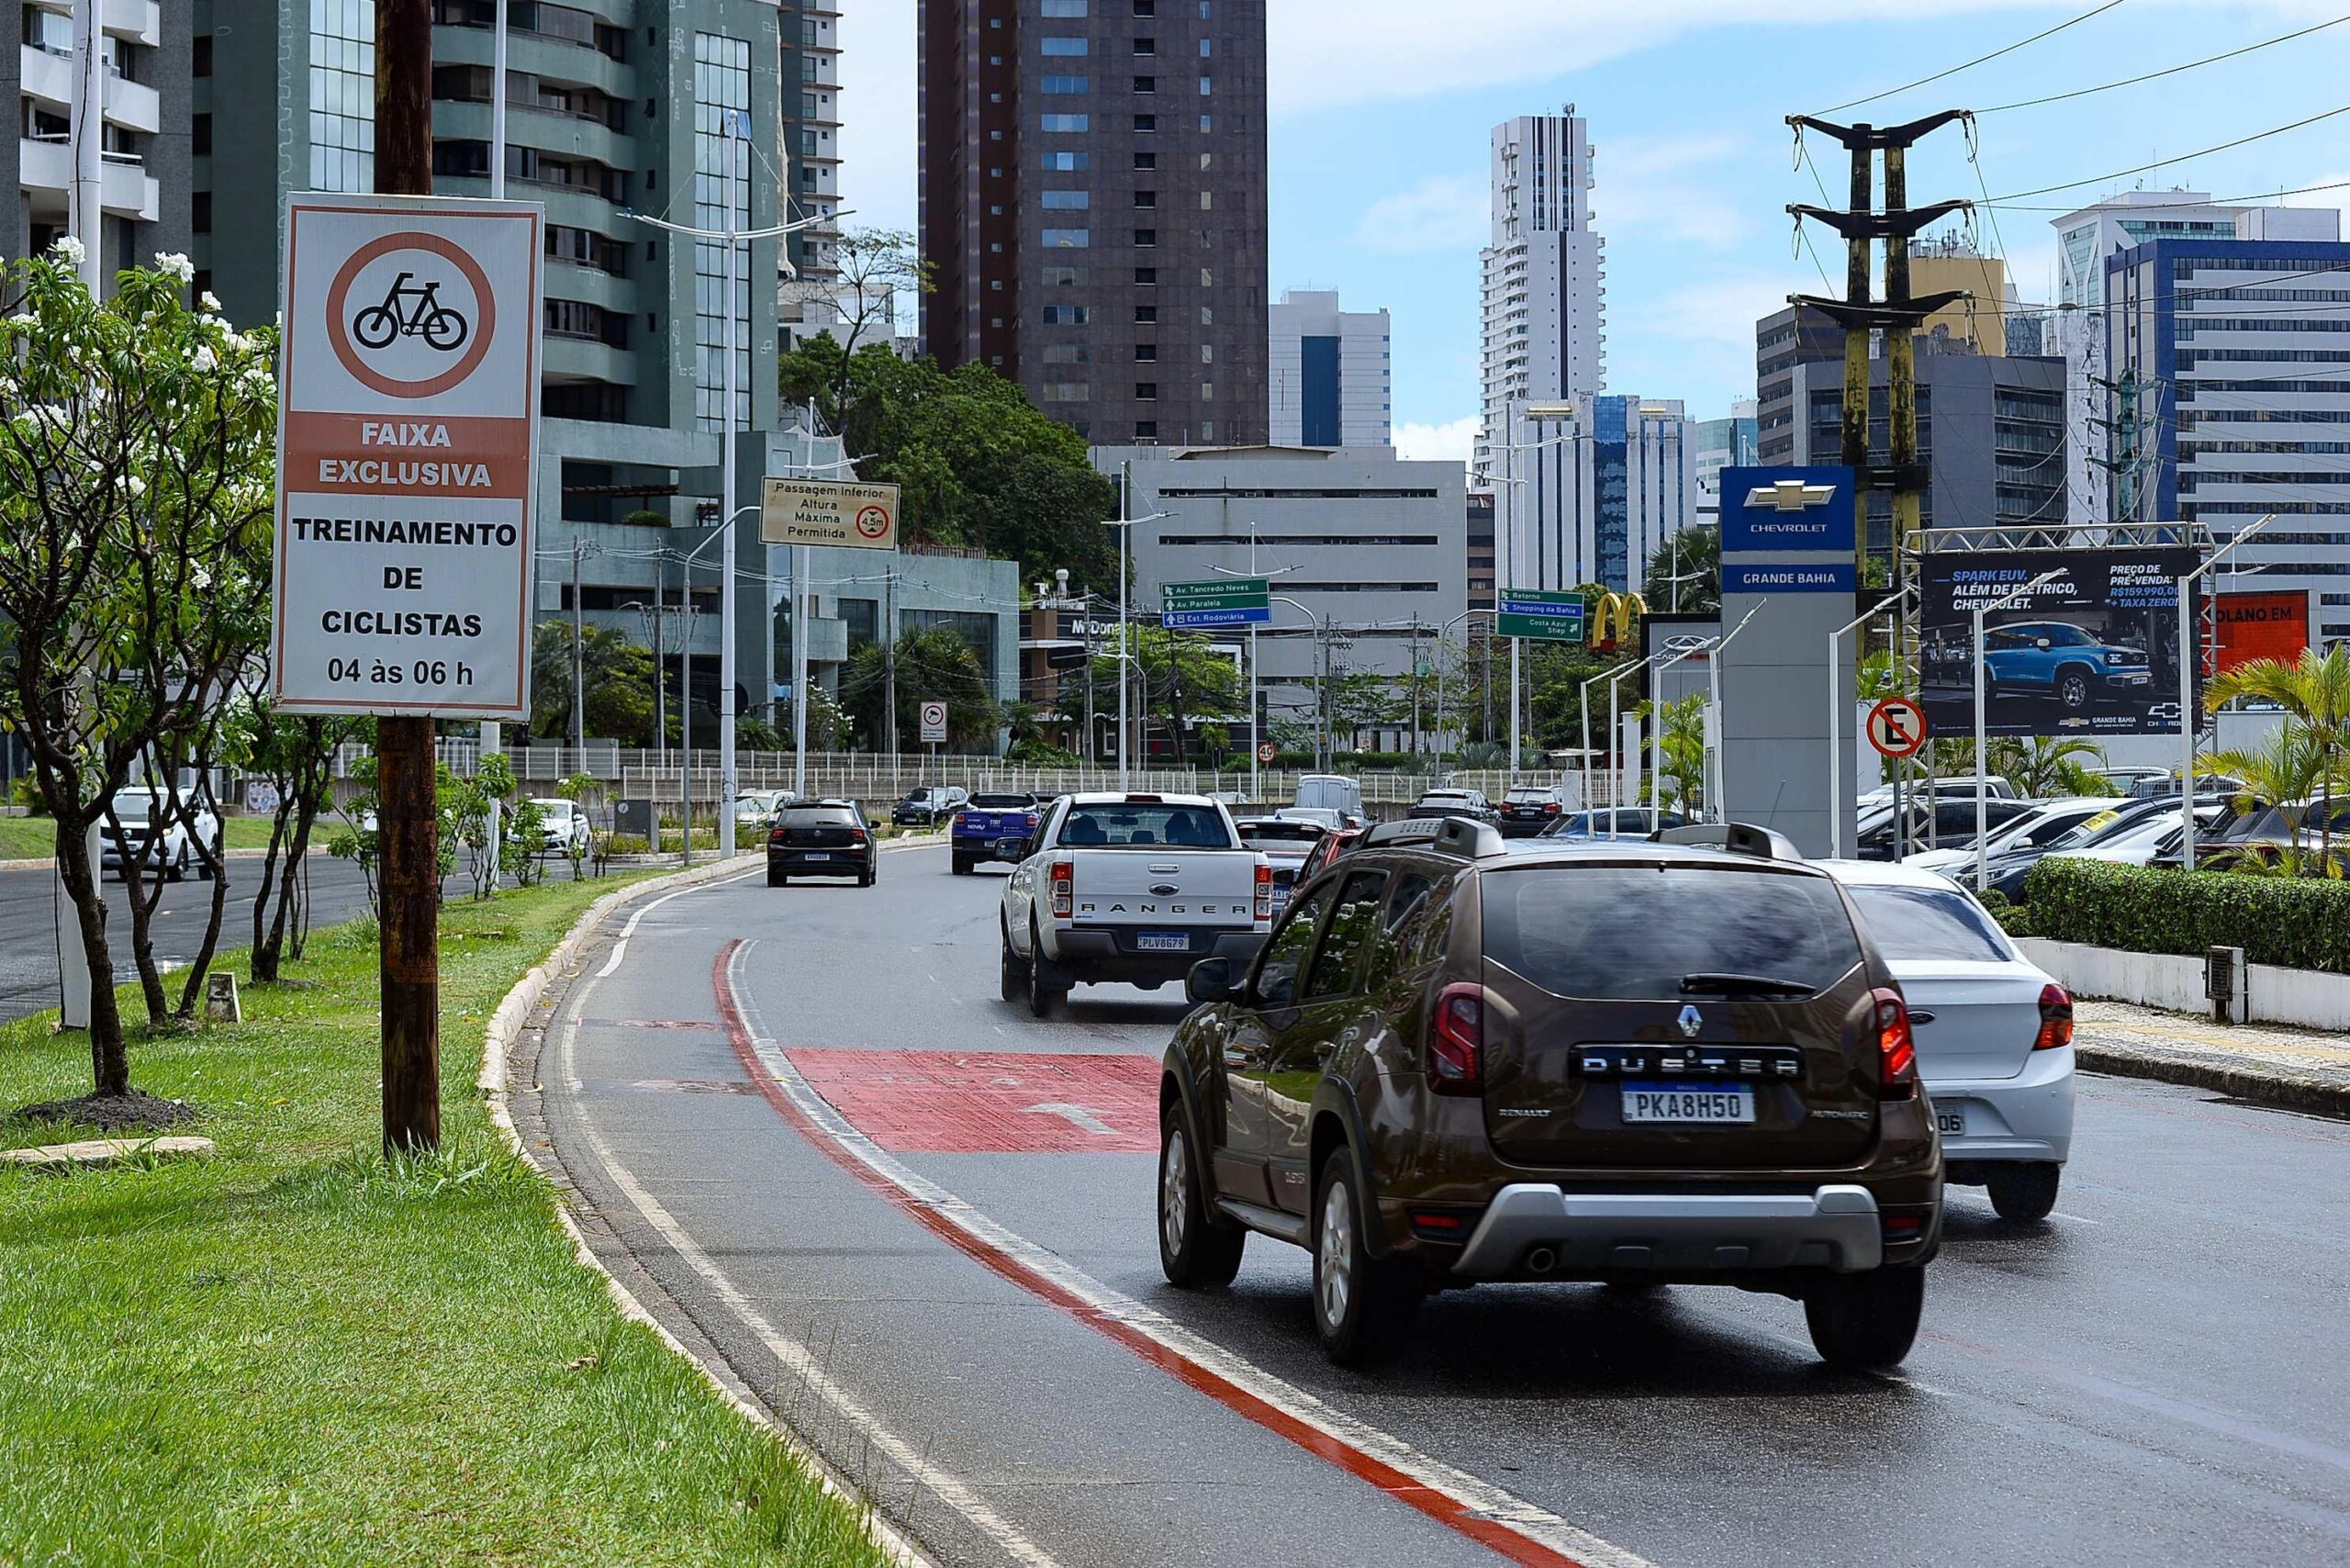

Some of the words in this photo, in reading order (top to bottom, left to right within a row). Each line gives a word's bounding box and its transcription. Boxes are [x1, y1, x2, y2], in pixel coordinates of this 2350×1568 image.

[362, 422, 452, 447] FAIXA
[319, 459, 492, 487] EXCLUSIVA
[776, 482, 837, 497] Passagem
[841, 486, 884, 498] Inferior
[800, 498, 838, 510] Altura
[795, 511, 840, 523] Máxima
[292, 518, 517, 546] TREINAMENTO
[788, 526, 845, 539] Permitida
[1751, 524, 1828, 532] CHEVROLET
[1953, 570, 1998, 582] SPARK
[1998, 569, 2028, 581] EUV.
[2109, 565, 2145, 577] PREÇO
[2146, 565, 2161, 573] DE
[383, 566, 422, 589] DE
[1743, 573, 1794, 584] GRANDE
[1797, 573, 1836, 584] BAHIA
[2109, 575, 2174, 586] PRÉ-VENDA:
[1225, 584, 1249, 592] Neves
[1952, 582, 1990, 596] ALÉM
[1992, 584, 2011, 596] DE
[1190, 599, 1221, 608] Paralela
[1512, 604, 1544, 613] Shopping
[2120, 599, 2146, 607] TAXA
[1203, 612, 1245, 622] Rodoviária
[2215, 609, 2266, 623] OLANO
[2272, 607, 2292, 621] EM
[322, 610, 482, 637] CICLISTAS
[328, 657, 361, 682] 04
[370, 658, 403, 683] às
[413, 660, 446, 685] 06
[457, 661, 473, 685] h
[1885, 709, 1909, 745] E
[1260, 746, 1273, 756] 40
[1080, 903, 1247, 914] RANGER
[1583, 1058, 1797, 1074] DUSTER
[1637, 1093, 1740, 1118] PKA8H50
[1498, 1108, 1551, 1117] RENAULT
